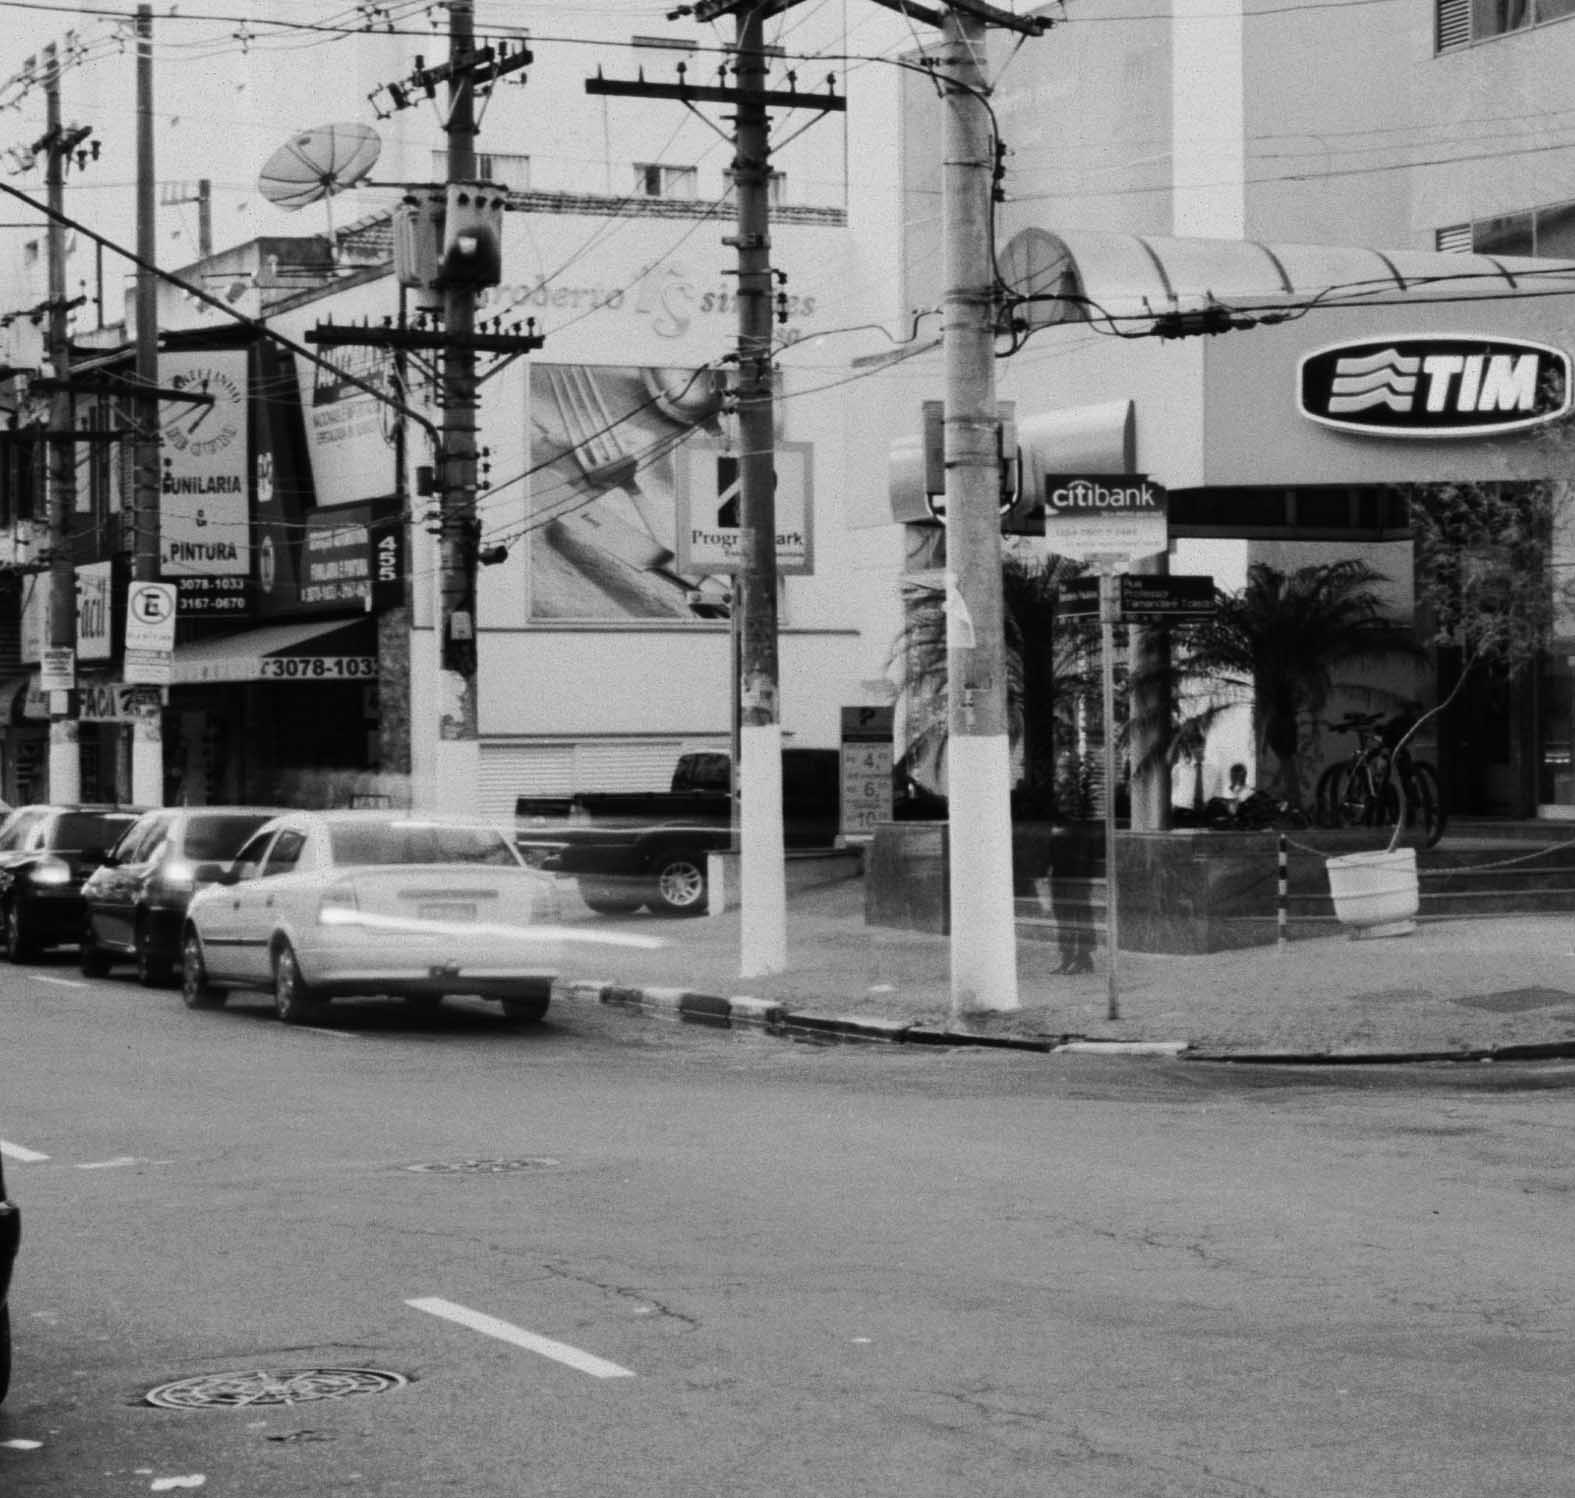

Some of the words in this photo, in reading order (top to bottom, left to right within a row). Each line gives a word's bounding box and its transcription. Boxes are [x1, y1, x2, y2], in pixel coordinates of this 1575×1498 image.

[1424, 355, 1539, 411] TIM
[1053, 481, 1155, 506] citibank
[170, 542, 238, 561] PINTURA
[776, 533, 802, 545] ark
[378, 536, 398, 581] 455
